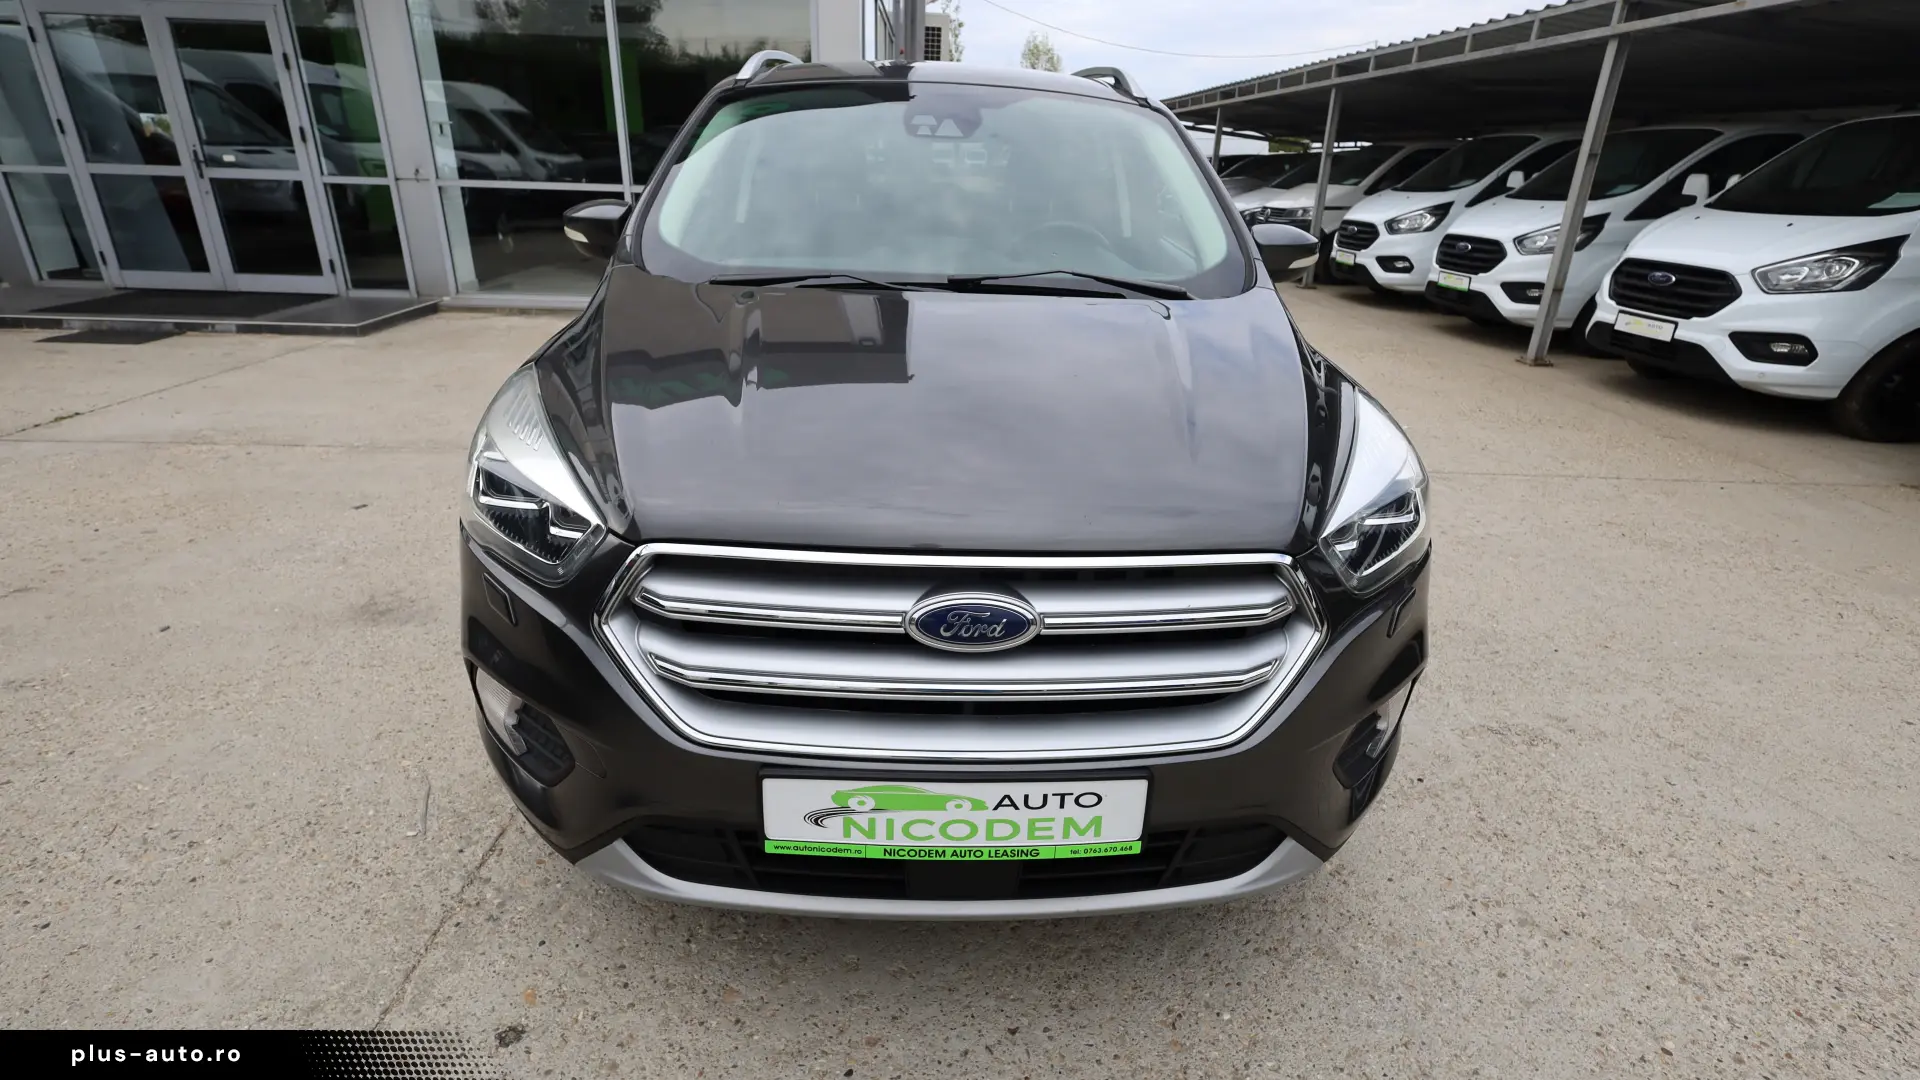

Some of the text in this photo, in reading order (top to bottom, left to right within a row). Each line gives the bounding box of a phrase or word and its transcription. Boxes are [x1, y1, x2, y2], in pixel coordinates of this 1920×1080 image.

[940, 610, 1008, 638] Ford
[993, 792, 1103, 811] AUTO
[842, 815, 1102, 841] NICODEM
[773, 844, 862, 854] www.autonicodem.ro
[883, 847, 1040, 859] NICODEM AUTO LEASING
[1083, 845, 1133, 855] 0763.670.468
